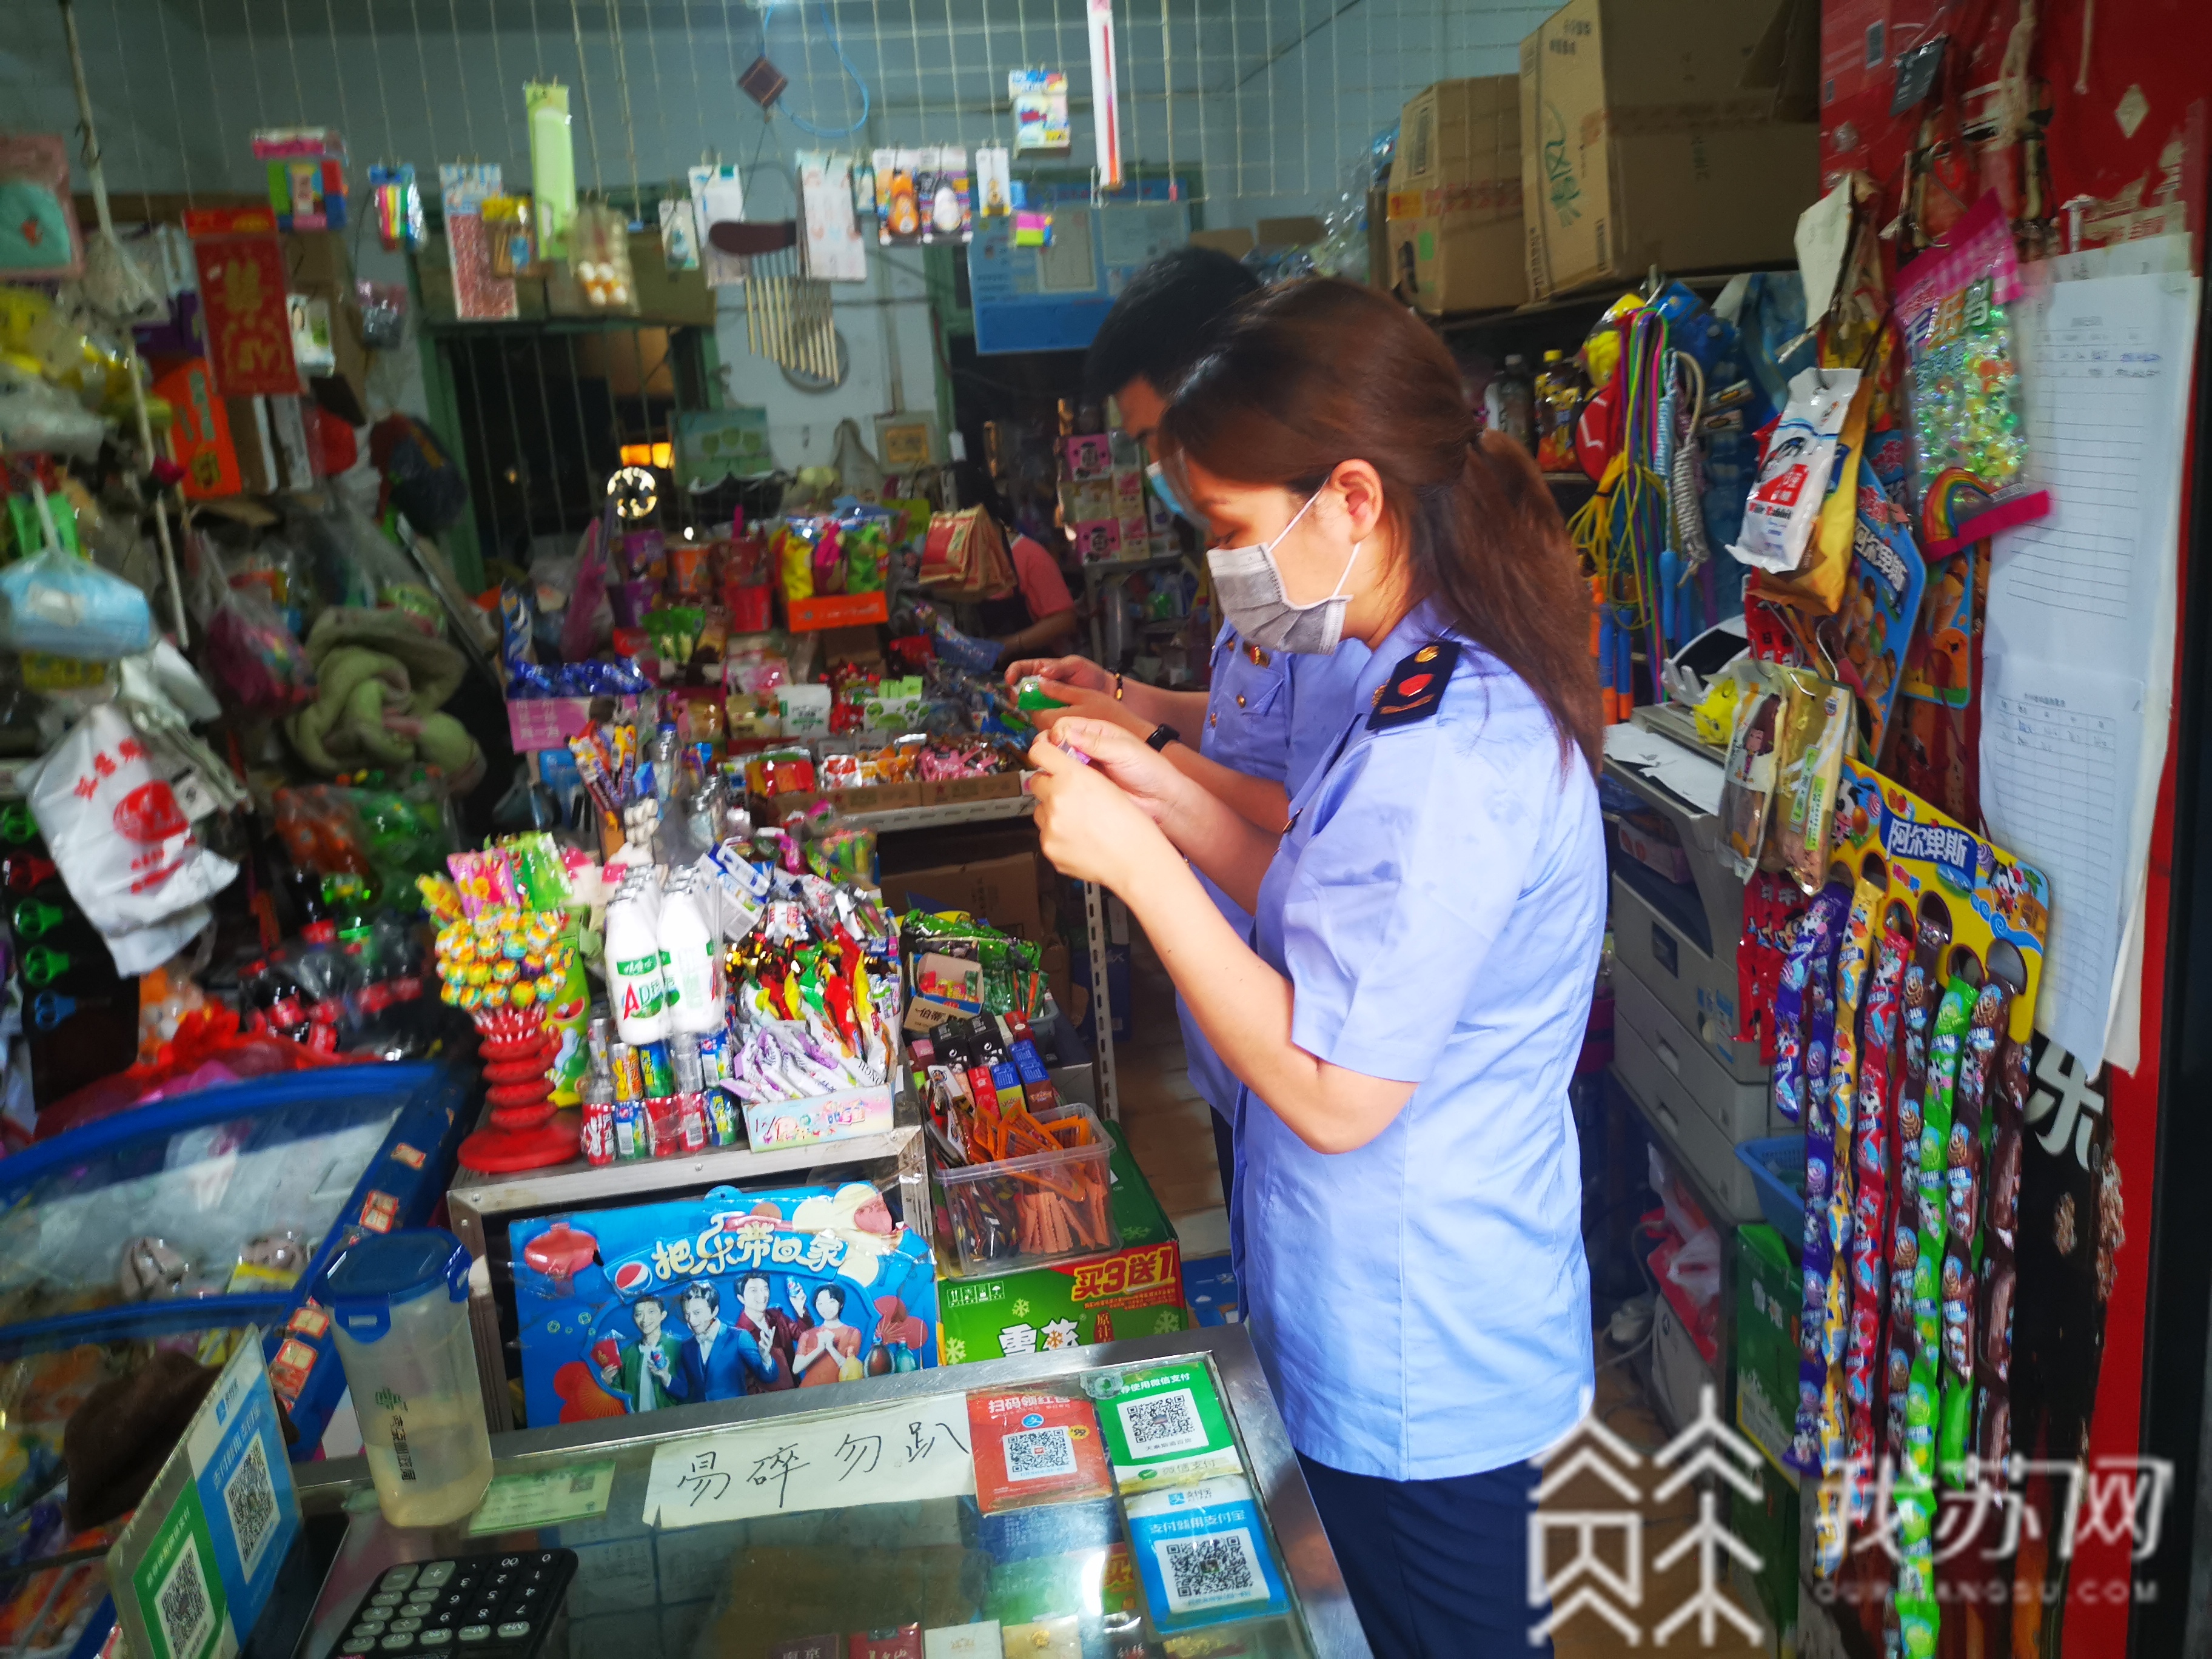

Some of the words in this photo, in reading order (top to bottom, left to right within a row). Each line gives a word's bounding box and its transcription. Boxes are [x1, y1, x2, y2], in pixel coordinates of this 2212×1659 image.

[1885, 818, 1969, 868] 阿尔卑斯
[651, 1211, 846, 1281] 把乐带回家
[1072, 1247, 1175, 1300] 买3送1
[988, 1395, 1070, 1413] 扫码领红包
[677, 1421, 970, 1508] 易碎勿趴
[1150, 1509, 1247, 1535] 支付就用支付宝
